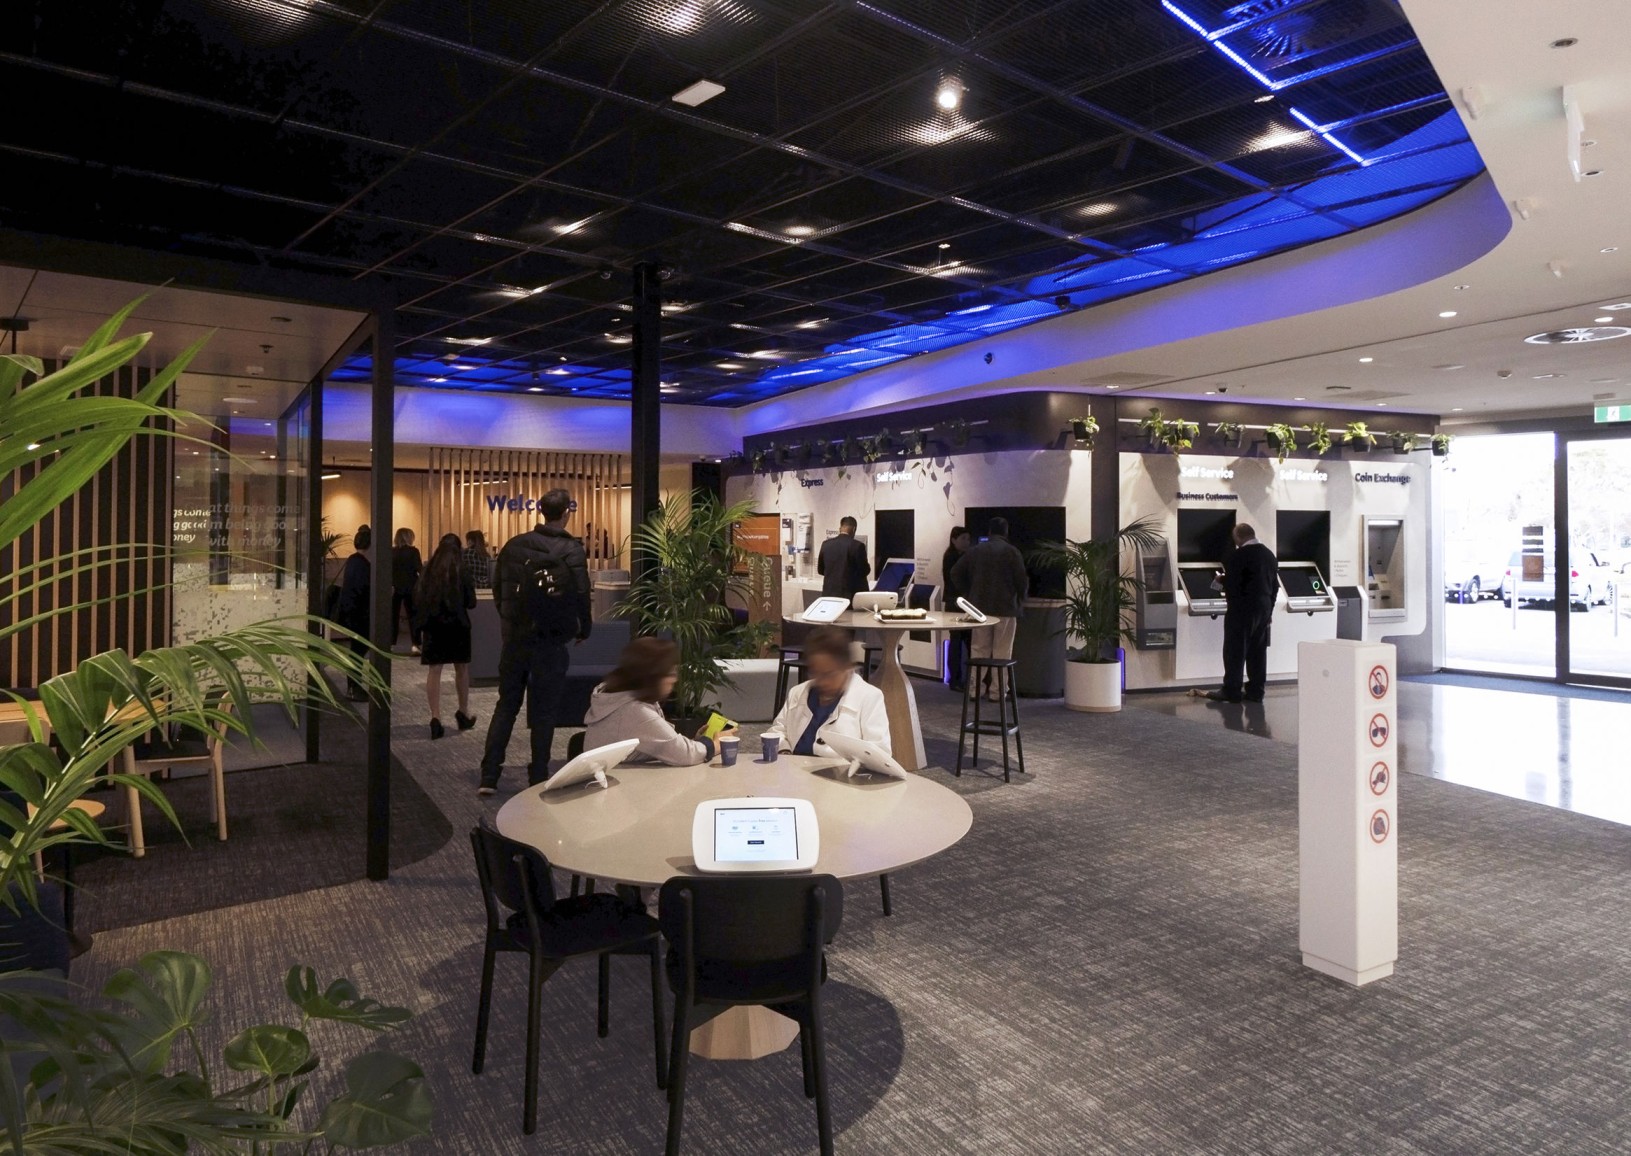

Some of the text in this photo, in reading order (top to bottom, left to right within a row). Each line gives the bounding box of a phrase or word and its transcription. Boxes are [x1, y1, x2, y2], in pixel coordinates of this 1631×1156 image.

[876, 470, 913, 482] Self Service
[1180, 466, 1234, 479] Self Service
[1279, 469, 1328, 482] Self Service
[1355, 472, 1411, 485] Coin Exchange
[801, 478, 824, 489] Express
[487, 494, 577, 511] Welcoe
[1176, 492, 1239, 501] Business Customers
[762, 557, 773, 598] Queue
